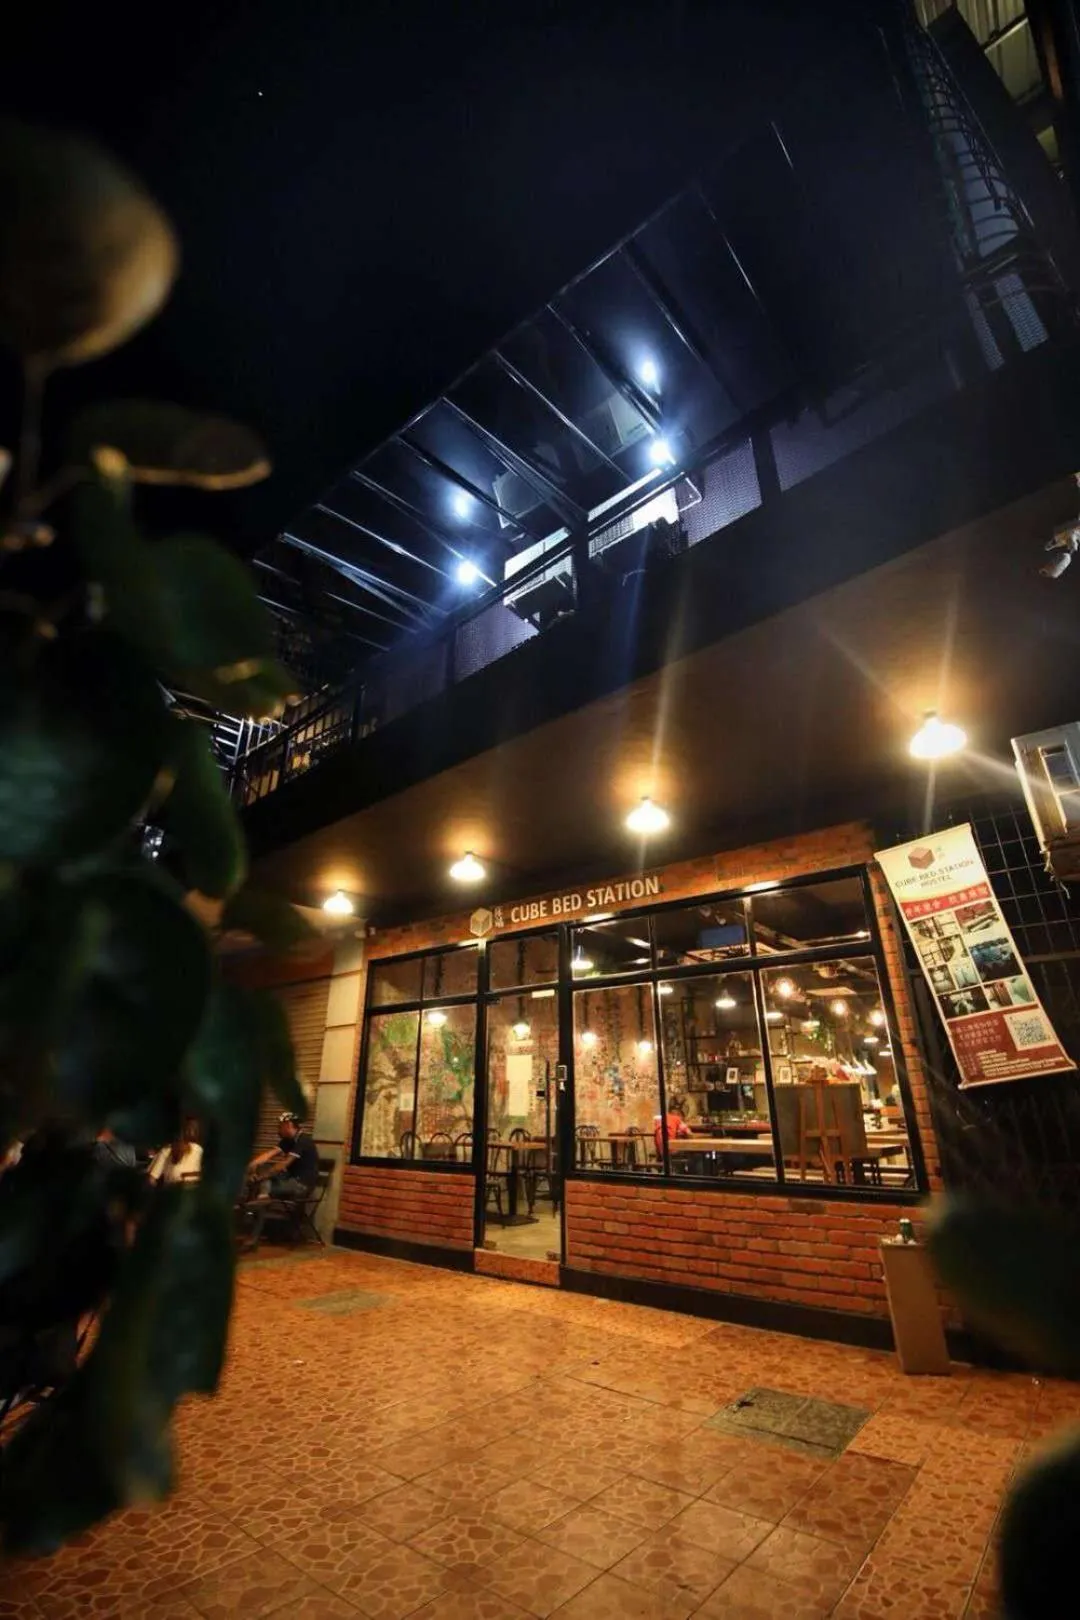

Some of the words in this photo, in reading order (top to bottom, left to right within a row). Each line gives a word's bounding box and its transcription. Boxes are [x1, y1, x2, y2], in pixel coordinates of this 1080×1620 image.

[895, 876, 917, 888] CUBE
[919, 871, 936, 882] BED
[938, 860, 974, 874] STATION
[511, 901, 547, 923] CUBE
[553, 894, 581, 914] BED
[587, 876, 659, 907] STATION
